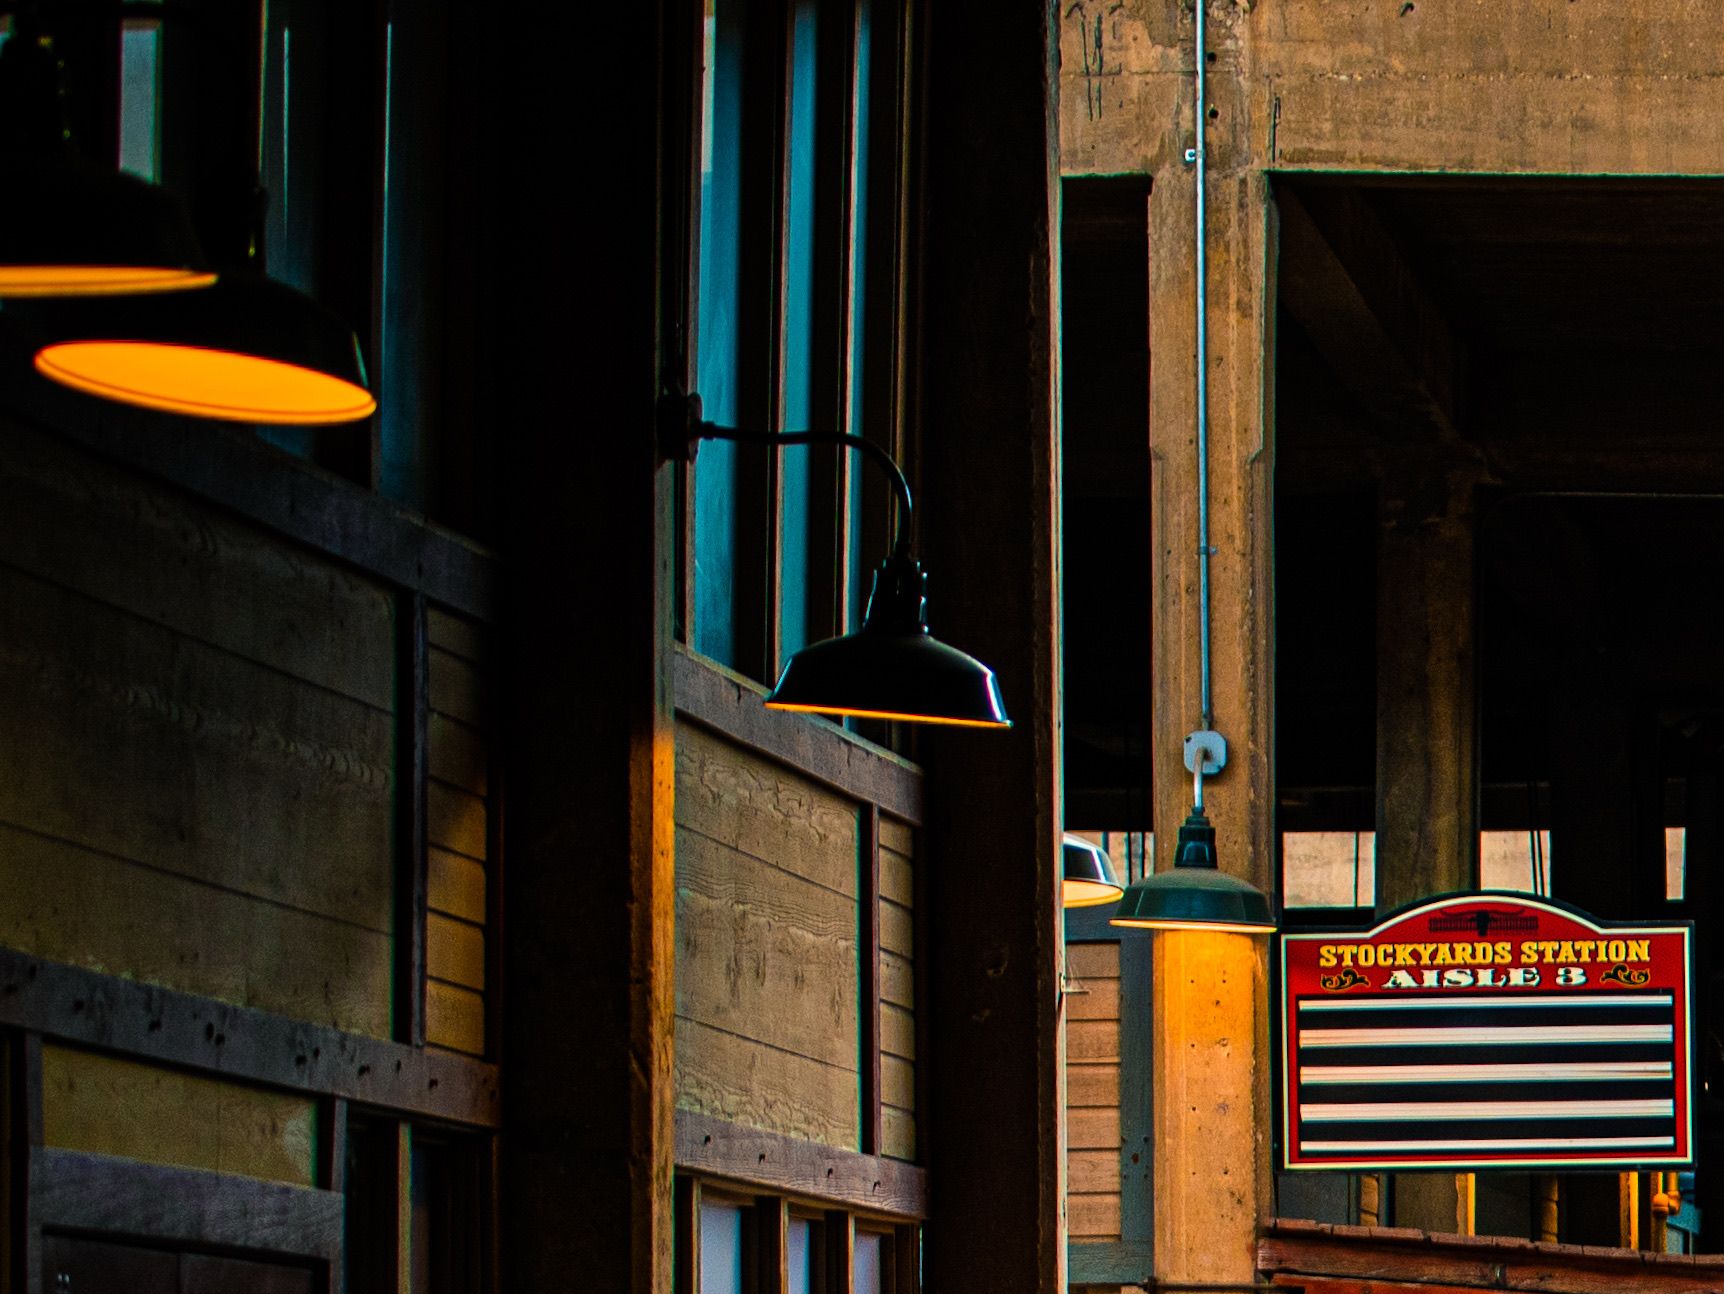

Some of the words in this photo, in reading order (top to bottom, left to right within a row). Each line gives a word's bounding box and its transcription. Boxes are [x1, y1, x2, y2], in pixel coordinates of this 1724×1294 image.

[1319, 941, 1512, 968] STOCKYARDS
[1520, 939, 1651, 965] STATION
[1380, 967, 1541, 989] AISLE
